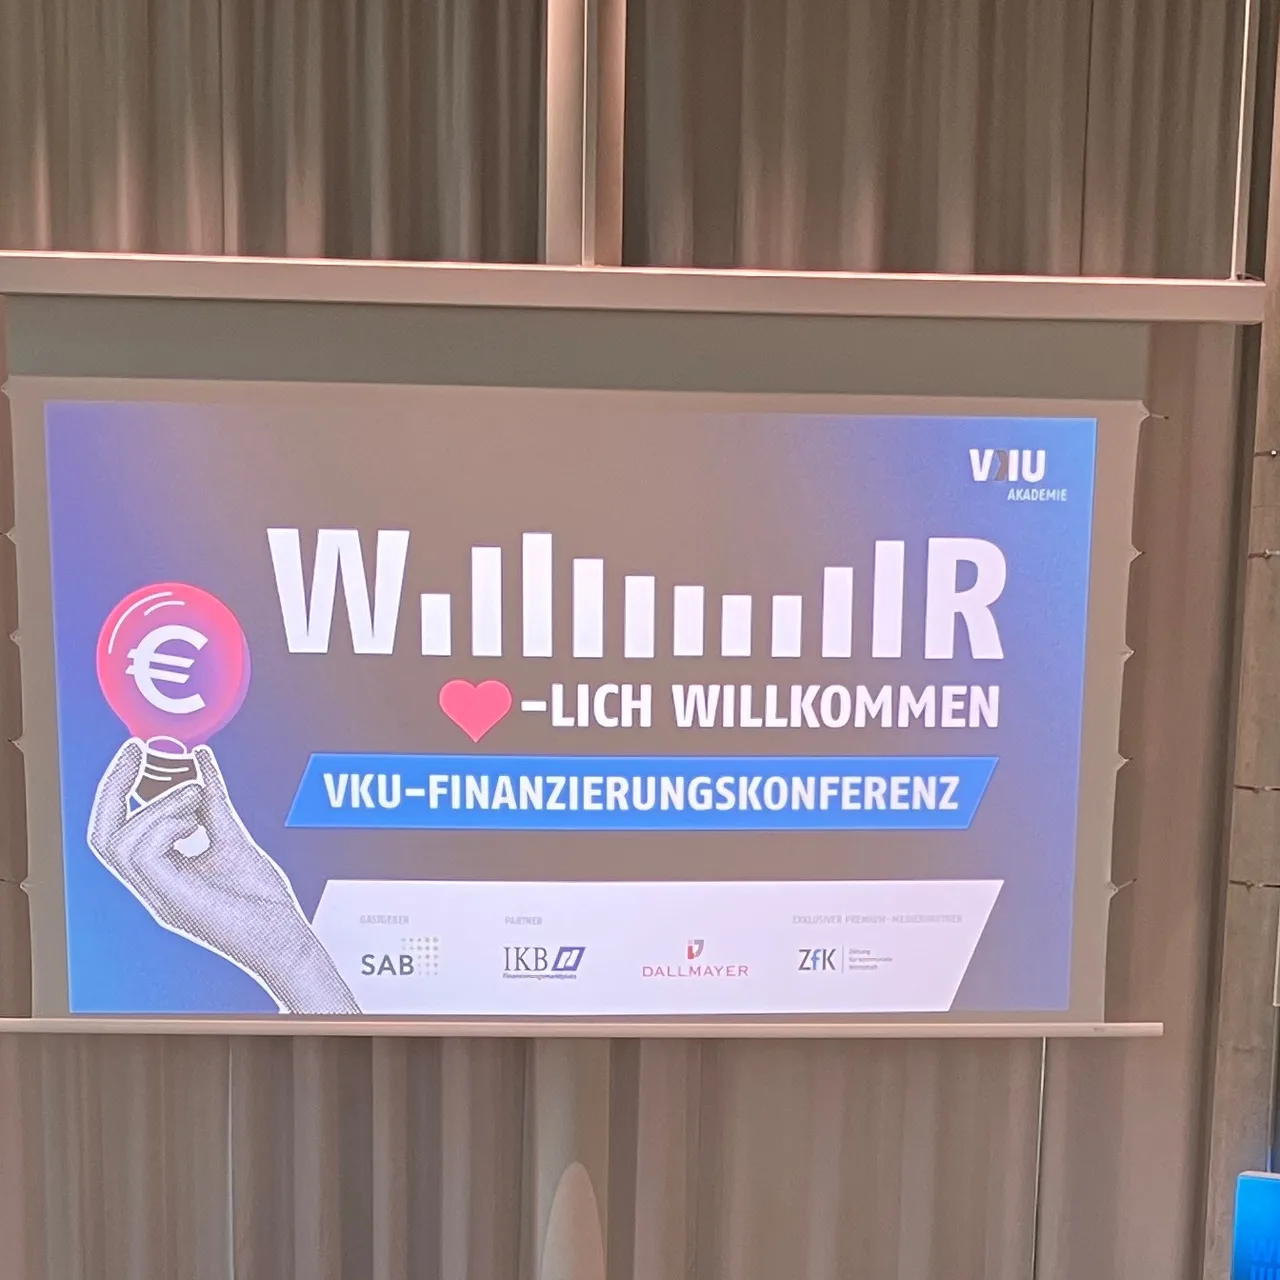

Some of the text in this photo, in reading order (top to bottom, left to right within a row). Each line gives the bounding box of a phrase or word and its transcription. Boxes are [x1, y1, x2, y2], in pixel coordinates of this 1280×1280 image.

[1007, 488, 1068, 501] AKADEMIE
[671, 684, 1000, 729] WILLKOMMEN
[322, 772, 960, 812] VKU-FINANZIERUNGSKONFERENZ
[360, 953, 415, 976] SAB
[503, 946, 548, 972] IKB
[797, 948, 837, 971] ZfK
[641, 964, 750, 978] DALLMAYER
